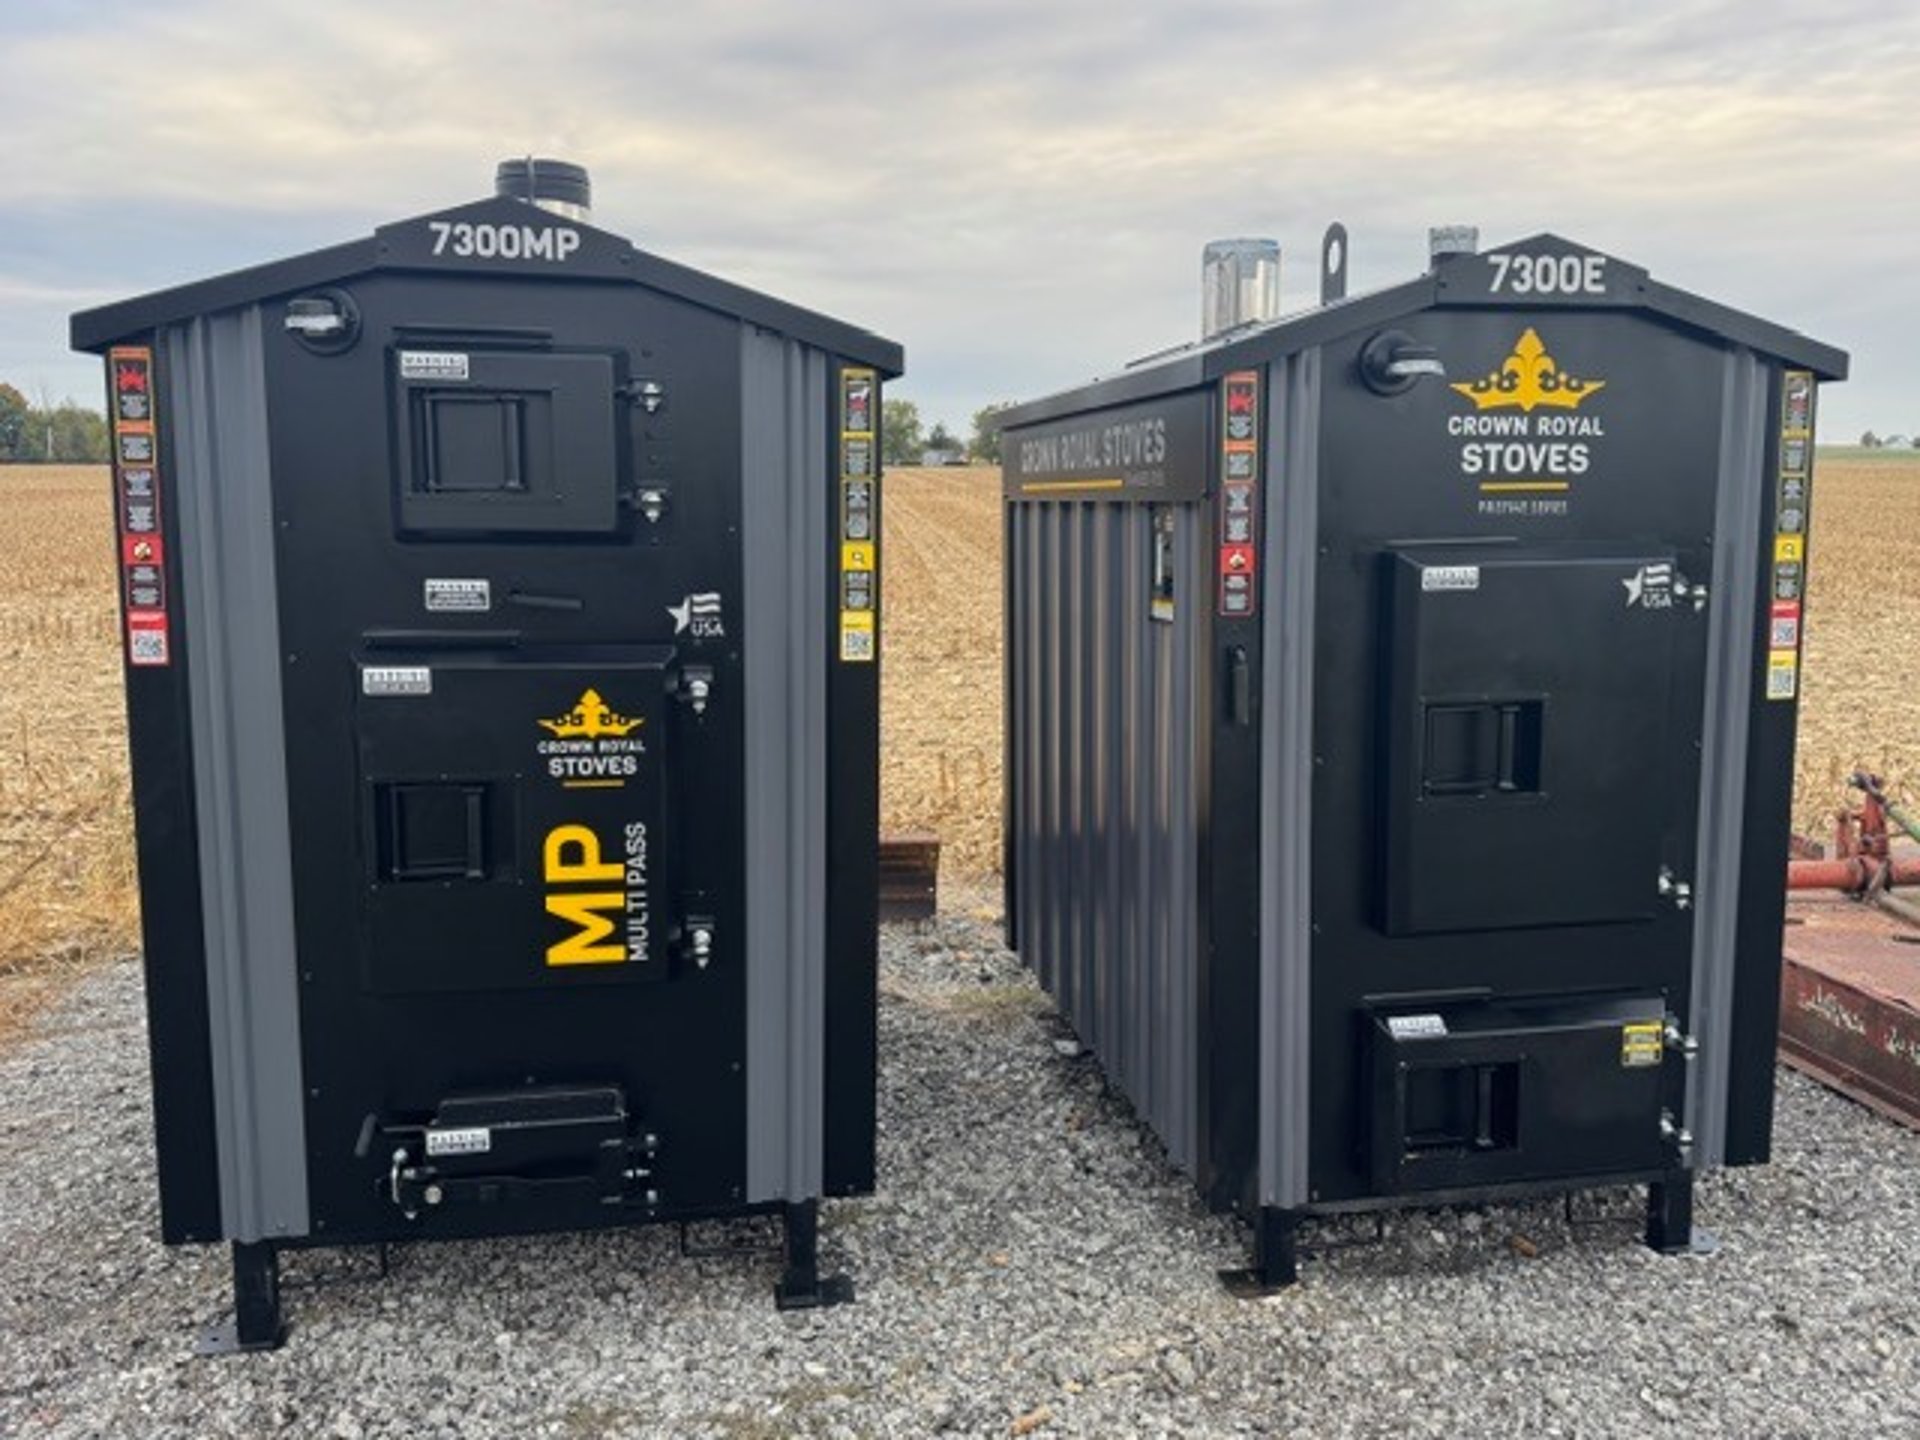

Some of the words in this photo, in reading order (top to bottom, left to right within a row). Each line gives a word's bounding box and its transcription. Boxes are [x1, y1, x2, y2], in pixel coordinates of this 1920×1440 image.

[429, 221, 580, 261] 7300MP
[1488, 254, 1606, 293] 7300E
[1103, 418, 1166, 467] STOVES
[1448, 415, 1528, 436] CROWN
[1538, 415, 1605, 436] ROYAL
[1461, 442, 1590, 473] STOVES
[1642, 593, 1672, 609] USA
[691, 619, 724, 637] USA
[537, 740, 594, 754] CROWN
[600, 740, 646, 754] ROYAL
[549, 755, 637, 777] STOVES
[625, 822, 647, 885] PASS
[545, 823, 625, 966] MP
[626, 891, 649, 961] MULTI
